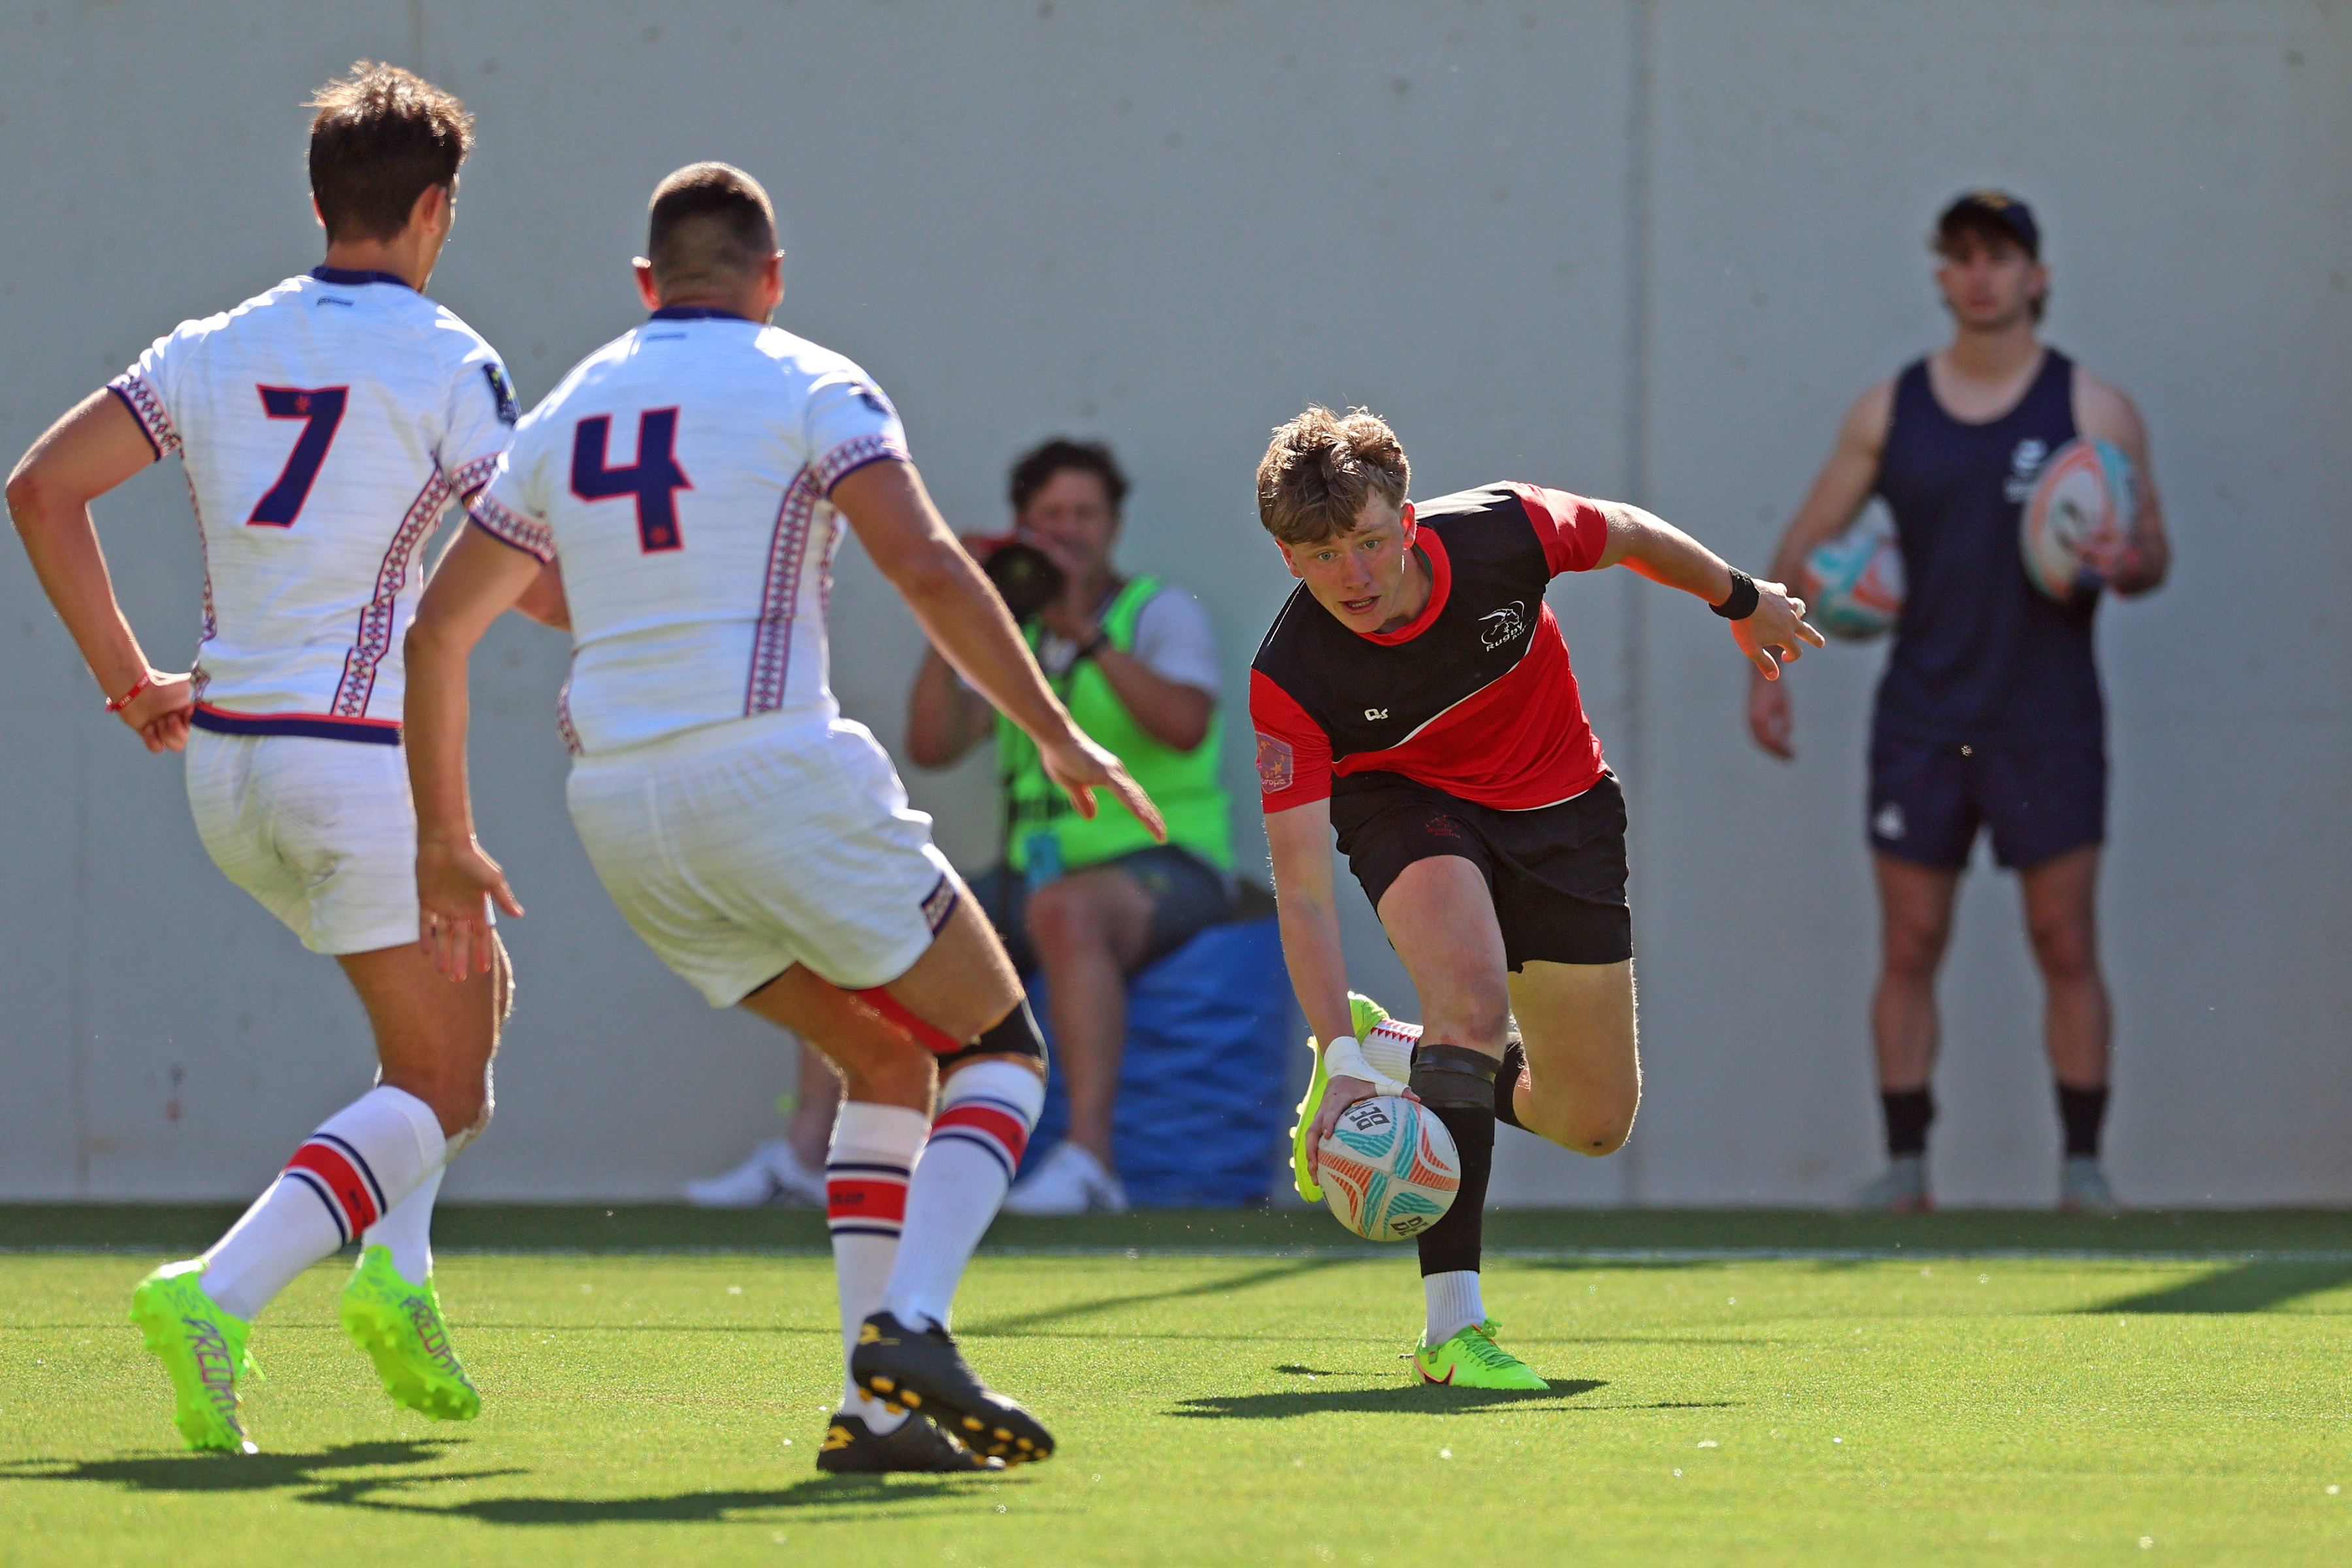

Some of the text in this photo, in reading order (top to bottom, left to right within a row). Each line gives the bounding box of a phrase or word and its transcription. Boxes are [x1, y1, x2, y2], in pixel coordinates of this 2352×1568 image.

[246, 383, 350, 529] 7
[570, 404, 694, 555] 4
[1486, 621, 1523, 652] Rugby
